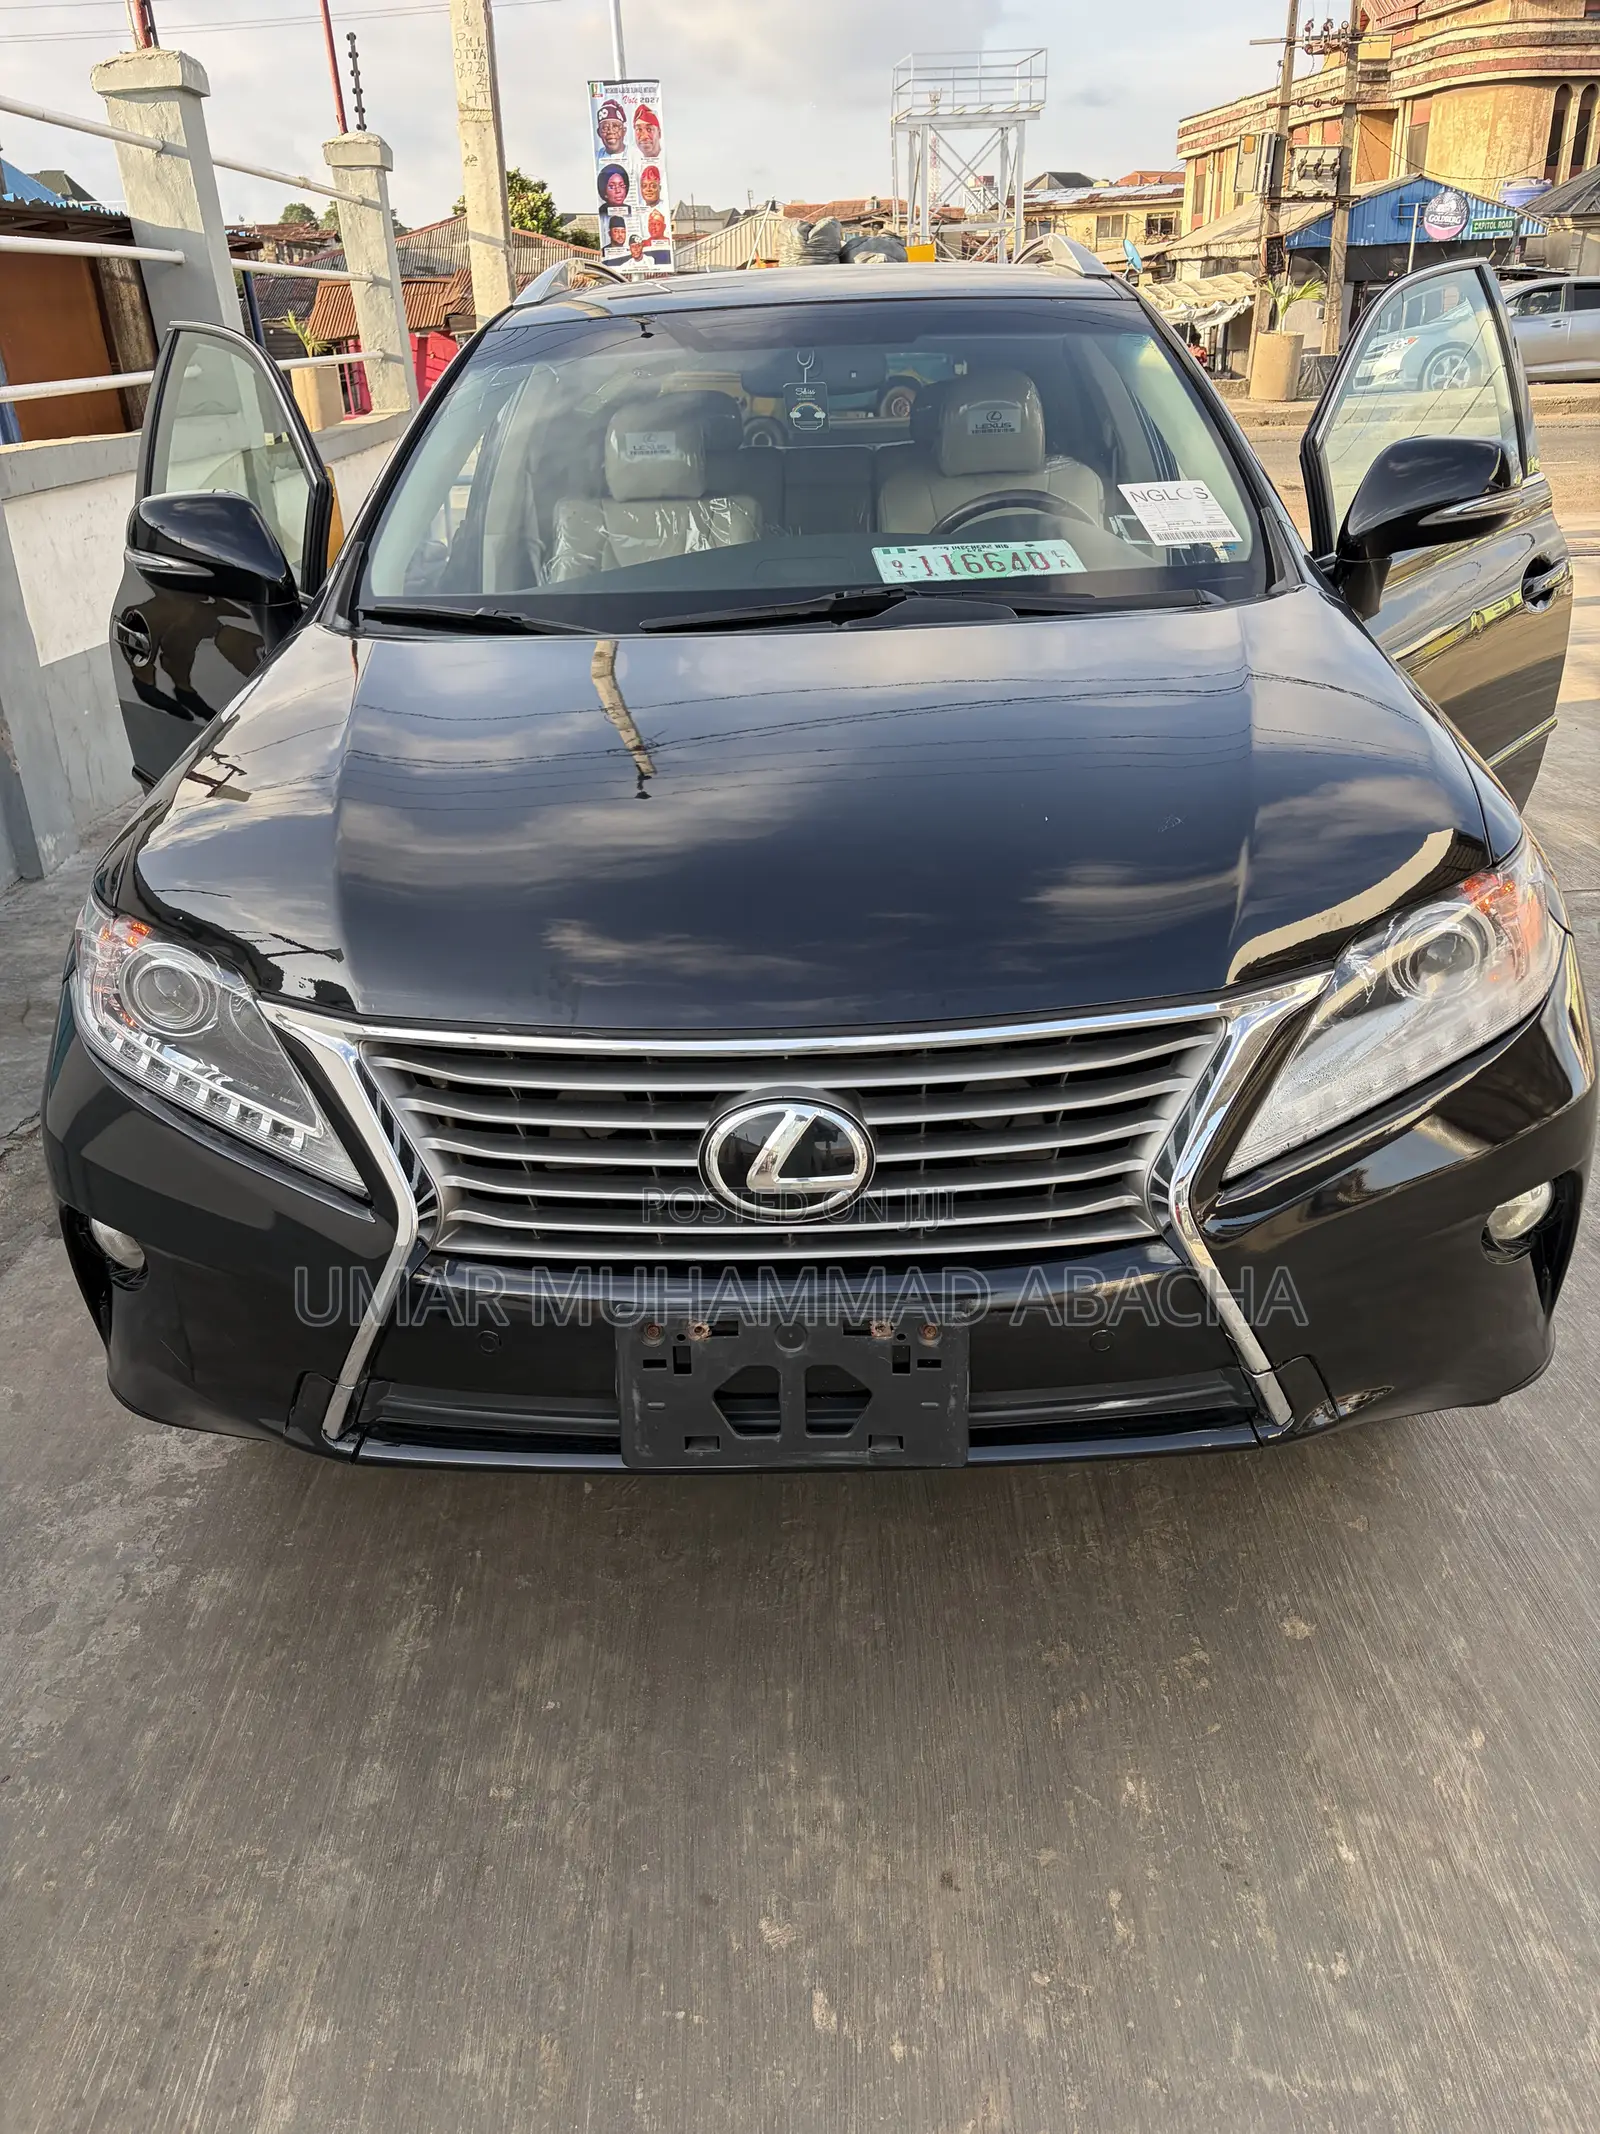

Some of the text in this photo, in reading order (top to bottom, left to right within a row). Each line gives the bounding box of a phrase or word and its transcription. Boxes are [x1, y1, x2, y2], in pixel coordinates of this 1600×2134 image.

[454, 48, 487, 60] OTTA
[1428, 214, 1461, 223] GOLDBERG
[1474, 220, 1512, 230] CAPITOL ROAD
[975, 422, 1012, 430] LEXUS
